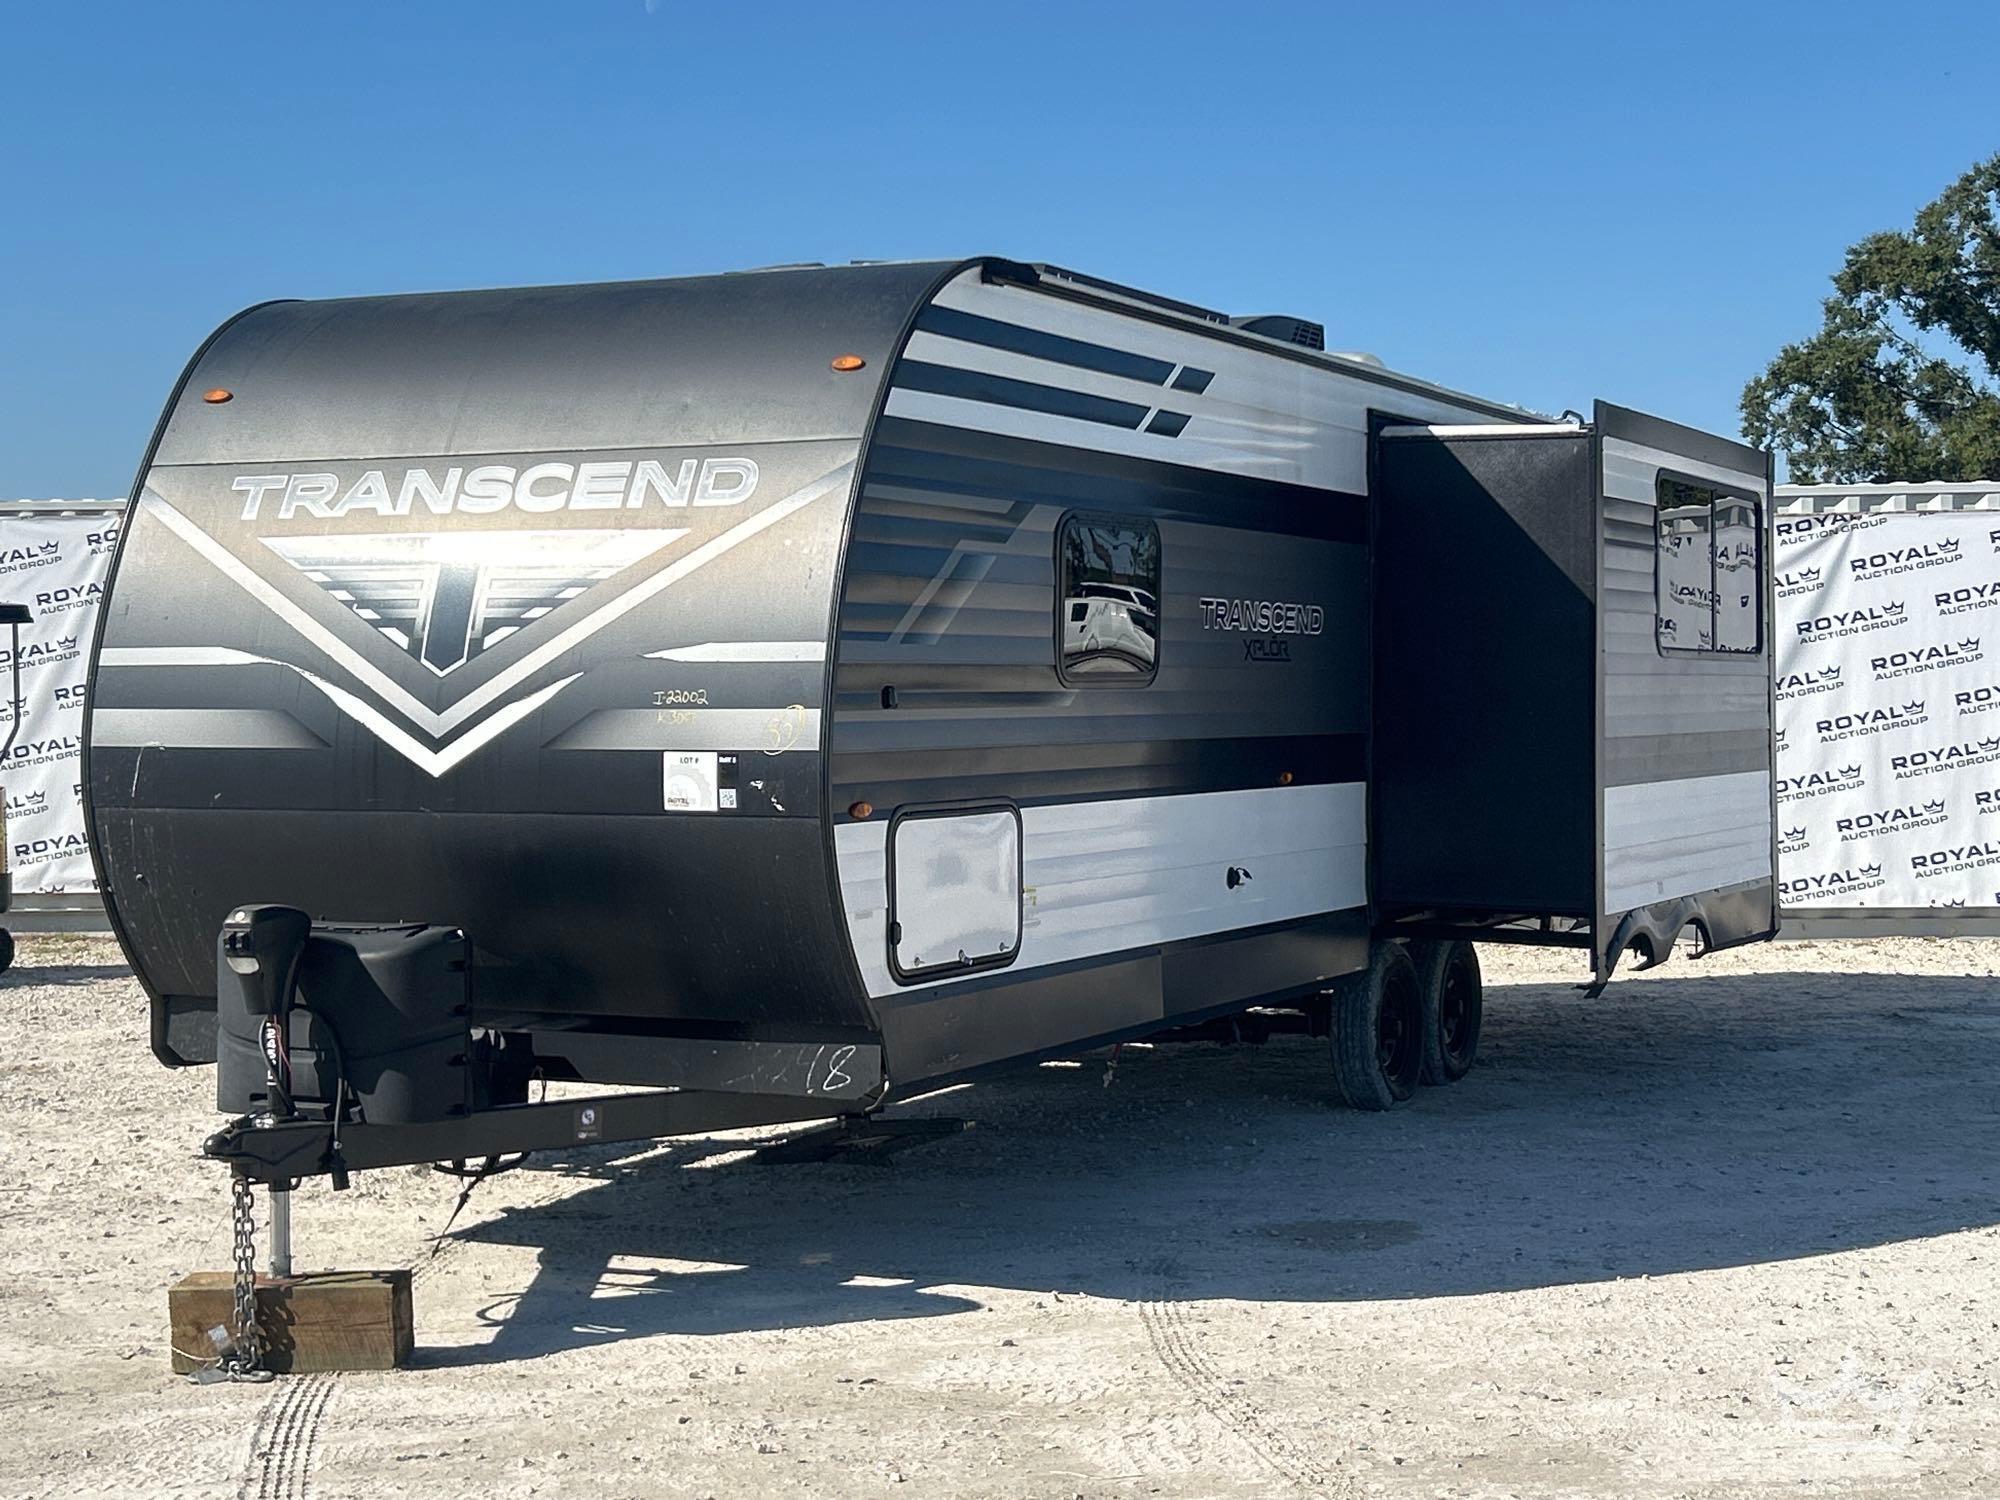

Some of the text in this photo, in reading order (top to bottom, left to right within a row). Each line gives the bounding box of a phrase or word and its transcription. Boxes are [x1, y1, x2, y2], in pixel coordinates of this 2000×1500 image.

[231, 457, 761, 520] TRANSCEND
[1780, 517, 1888, 547] AUCTION GROUP
[20, 556, 62, 570] GROUP
[1850, 545, 1938, 572] ROYAL
[1854, 553, 1963, 582] AUCTION GROUP
[1777, 582, 1824, 598] GROUP
[39, 598, 94, 616] AUCTION
[1200, 597, 1324, 635] TRANSCEND
[1939, 598, 1998, 616] AUCTION
[1796, 607, 1883, 635] ROYAL
[1799, 616, 1908, 645] AUCTION GROUP
[38, 650, 81, 666] GROUP
[1871, 644, 1958, 671] ROYAL
[1874, 653, 1984, 681] AUCTION GROUP
[1797, 681, 1844, 697] GROUP
[1816, 706, 1904, 734] ROYAL
[1820, 715, 1929, 743] AUCTION GROUP
[0, 754, 54, 771] AUCTION
[1891, 743, 1978, 770] ROYAL
[1895, 762, 1954, 780] AUCTION
[1817, 780, 1865, 796] GROUP
[1836, 806, 1923, 832] ROYAL
[1841, 815, 1948, 842] AUCTION GROUP
[19, 850, 73, 867] AUCTION
[1911, 843, 1998, 869] ROYAL
[1915, 861, 1974, 880] AUCTION
[1838, 879, 1885, 894] GROUP
